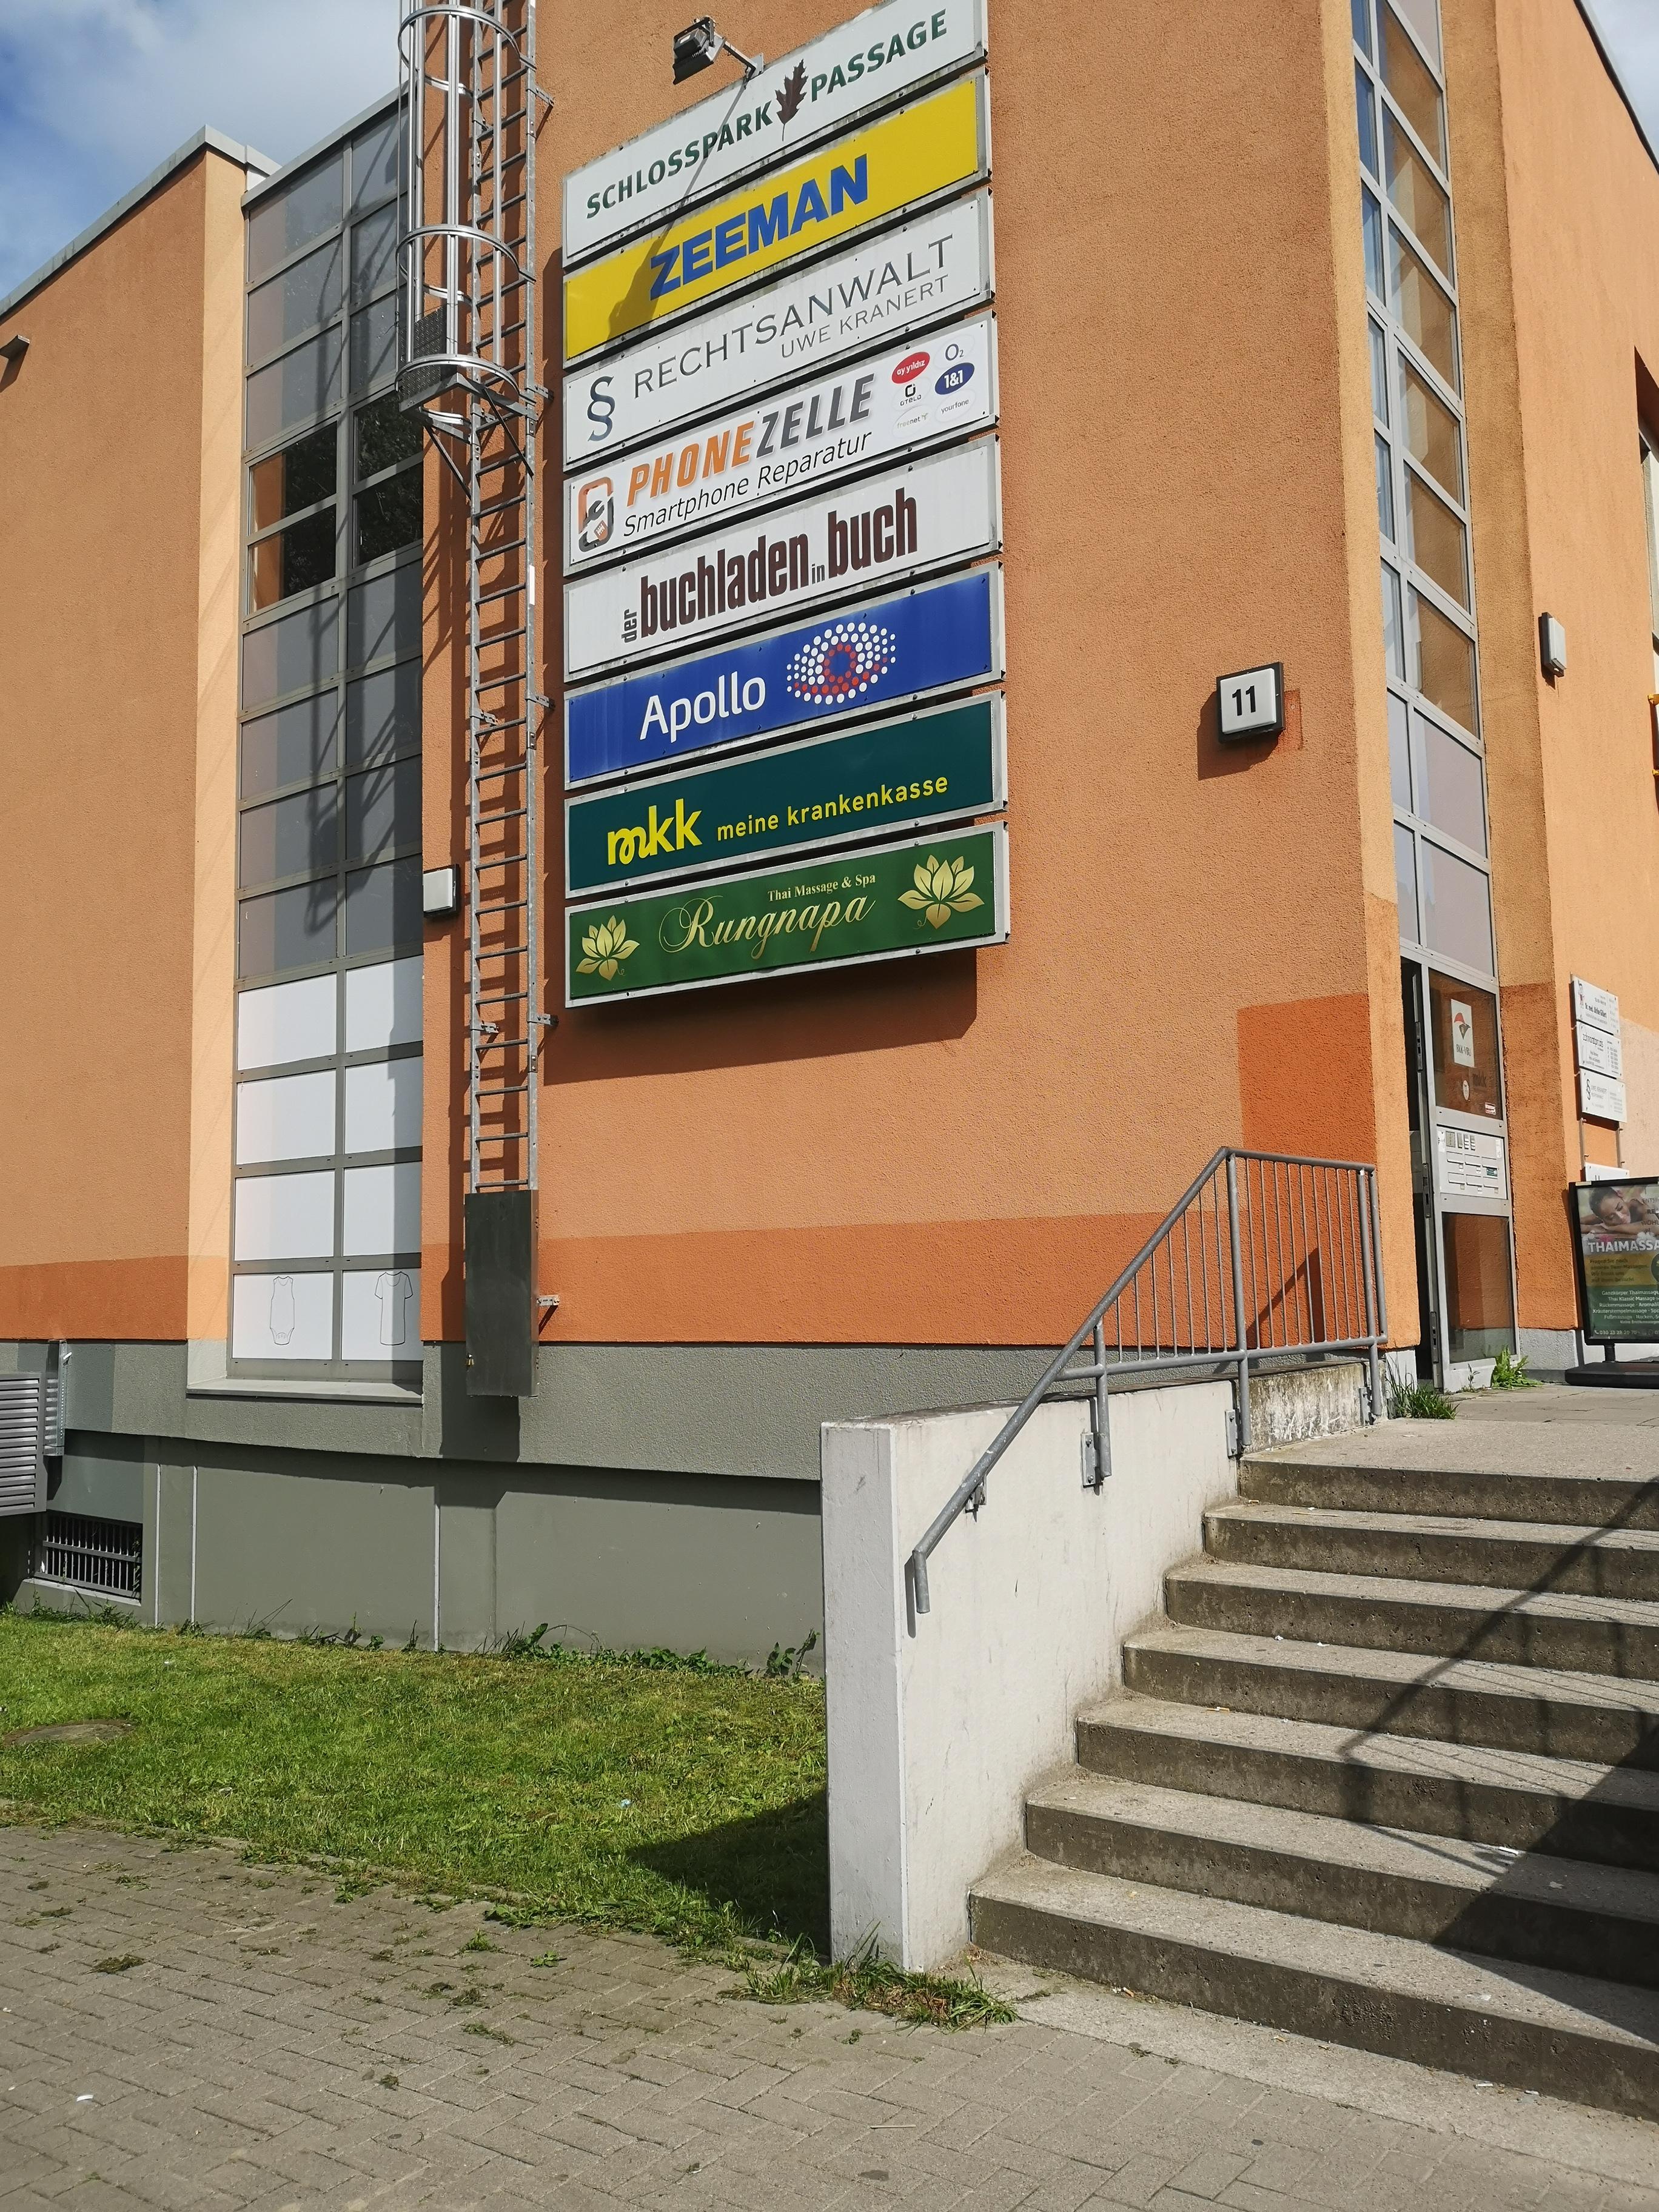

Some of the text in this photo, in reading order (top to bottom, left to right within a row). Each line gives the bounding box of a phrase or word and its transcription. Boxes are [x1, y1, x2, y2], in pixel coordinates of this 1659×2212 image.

[586, 9, 948, 219] SCHLOSSPARK PASSAGE
[649, 153, 868, 301] ZEEMAN
[634, 233, 953, 398] RECHTSANWALT
[781, 274, 948, 358] UWE KRANERT
[941, 398, 969, 414] yourfone
[944, 370, 963, 389] 1&1
[626, 374, 875, 508] PHONEZELLE
[897, 417, 920, 429] freenet
[623, 431, 872, 537] Smartphone Reparatur
[621, 486, 917, 643] der buchladen in buch
[640, 671, 766, 743] Apollo
[1232, 685, 1256, 717] 11
[608, 776, 948, 865] mkk meine krankenkasse
[659, 895, 876, 959] Rungnapa
[767, 873, 876, 902] Thai Massage & Spa
